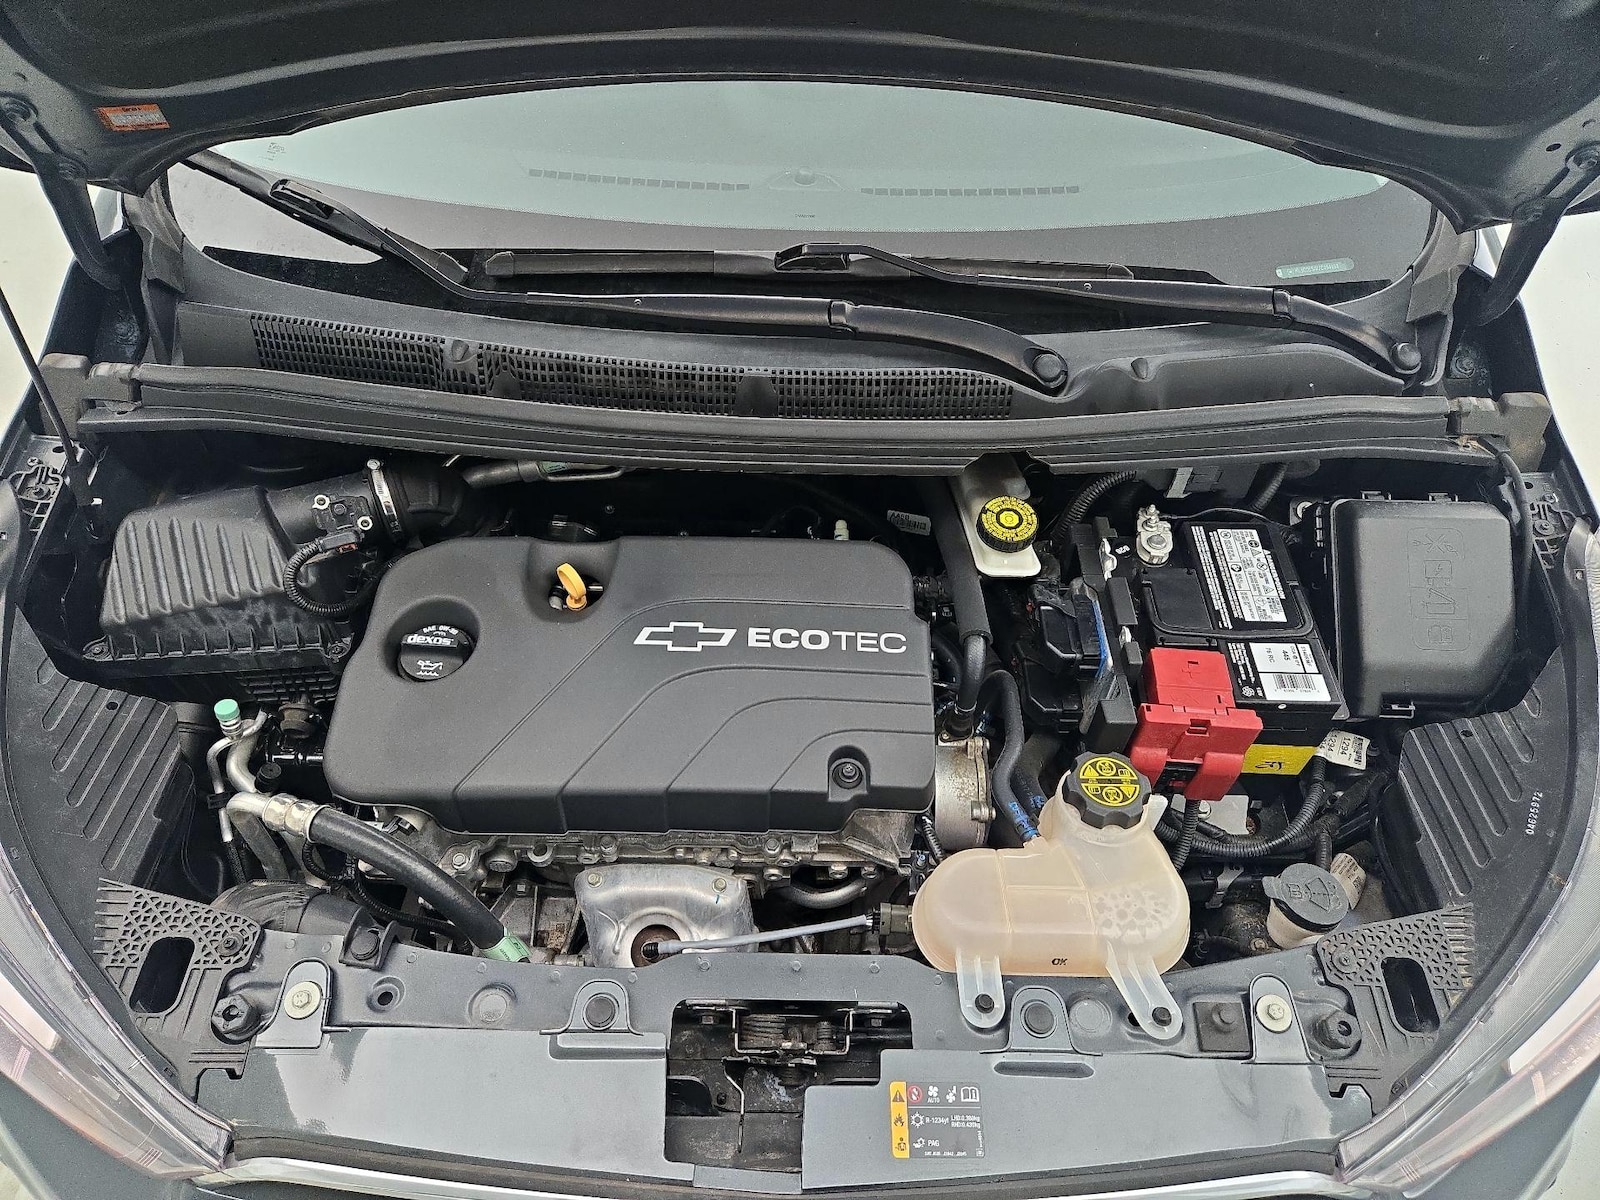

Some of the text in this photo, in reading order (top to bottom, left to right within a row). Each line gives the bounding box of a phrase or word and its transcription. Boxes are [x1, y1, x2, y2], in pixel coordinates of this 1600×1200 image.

[422, 625, 437, 633] SAE
[407, 634, 454, 646] dexos
[747, 627, 907, 654] ECOTEC
[1327, 734, 1337, 752] 1294
[1340, 736, 1351, 755] 1294
[1051, 958, 1068, 966] OK
[925, 1116, 949, 1125] R-1234yf
